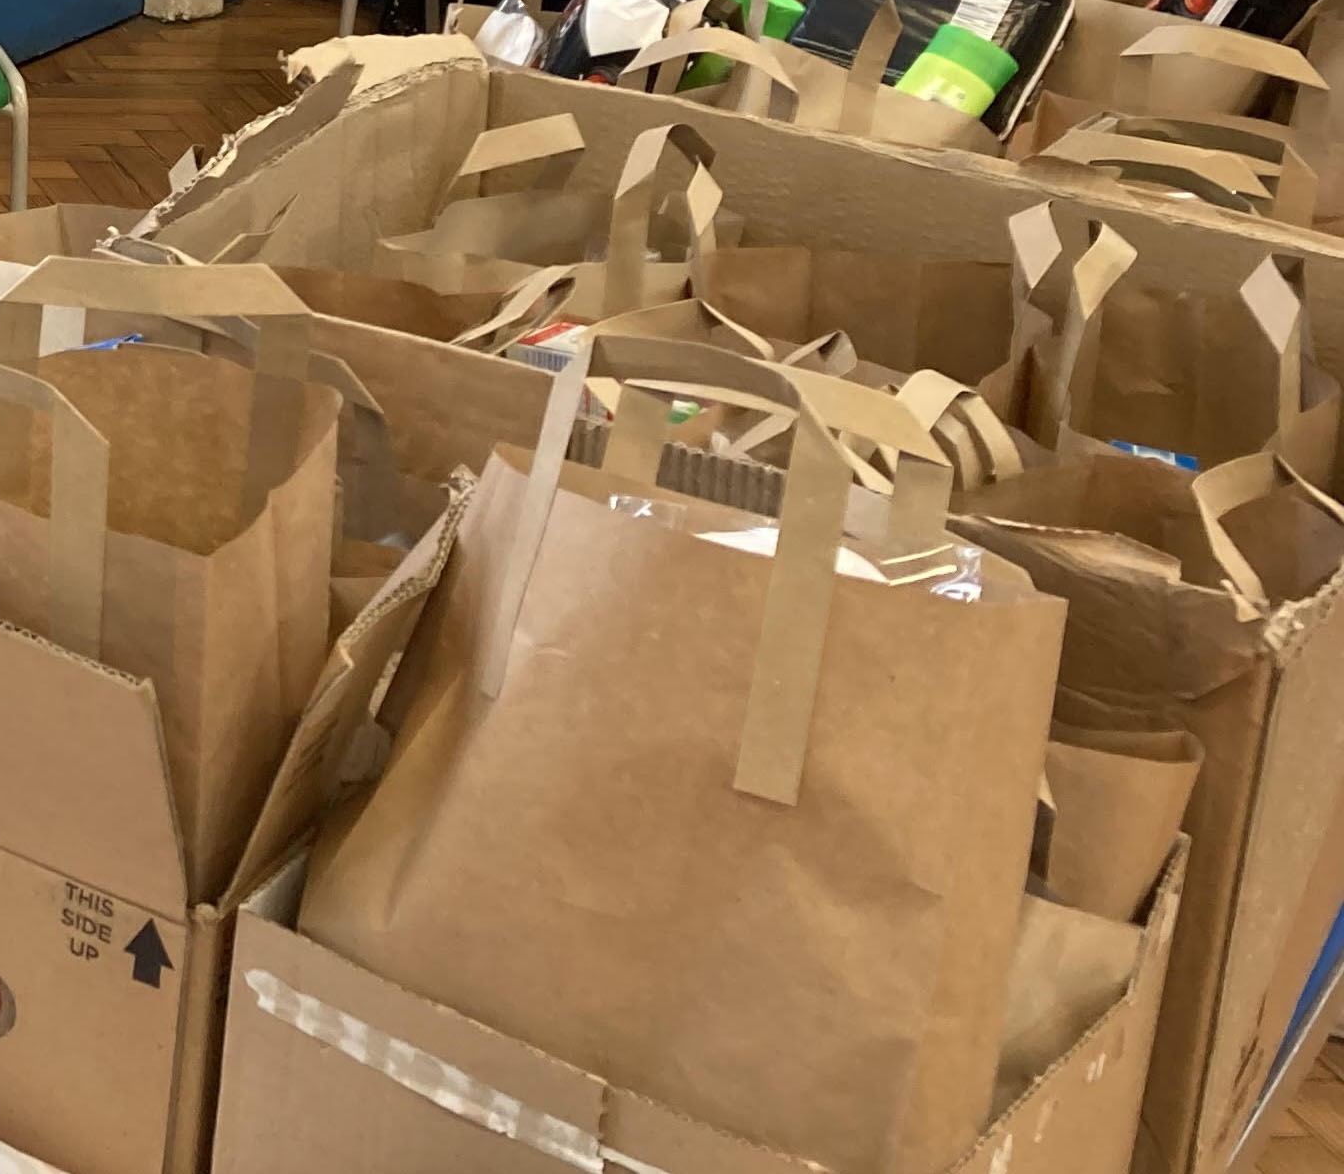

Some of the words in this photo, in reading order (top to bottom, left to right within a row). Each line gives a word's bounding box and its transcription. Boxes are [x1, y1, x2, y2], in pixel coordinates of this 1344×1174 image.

[65, 882, 114, 918] THIS
[61, 908, 112, 945] SIDE
[70, 937, 100, 961] UP
